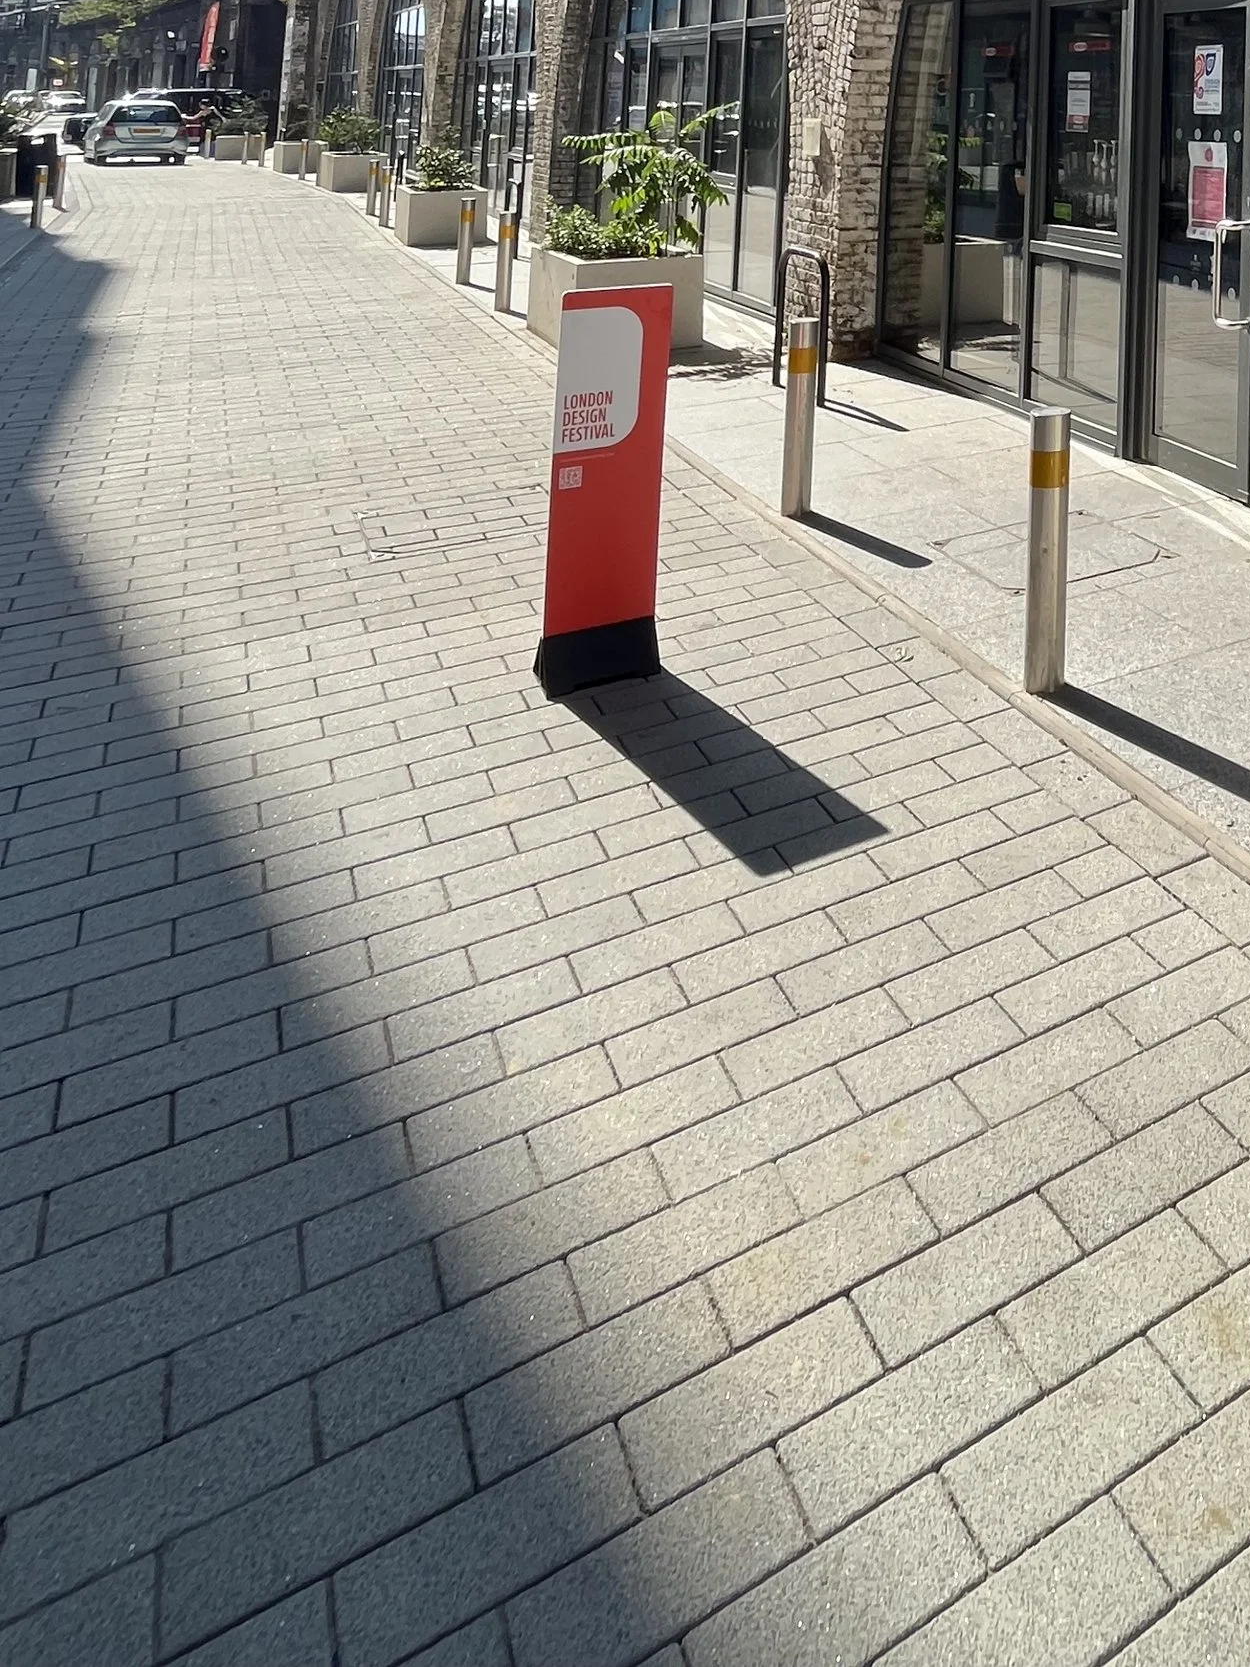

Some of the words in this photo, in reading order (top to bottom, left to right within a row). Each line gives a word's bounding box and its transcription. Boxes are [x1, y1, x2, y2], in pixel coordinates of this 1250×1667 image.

[563, 390, 614, 410] LONDON
[562, 407, 607, 427] DESIGN
[561, 423, 616, 444] FESTIVAL
